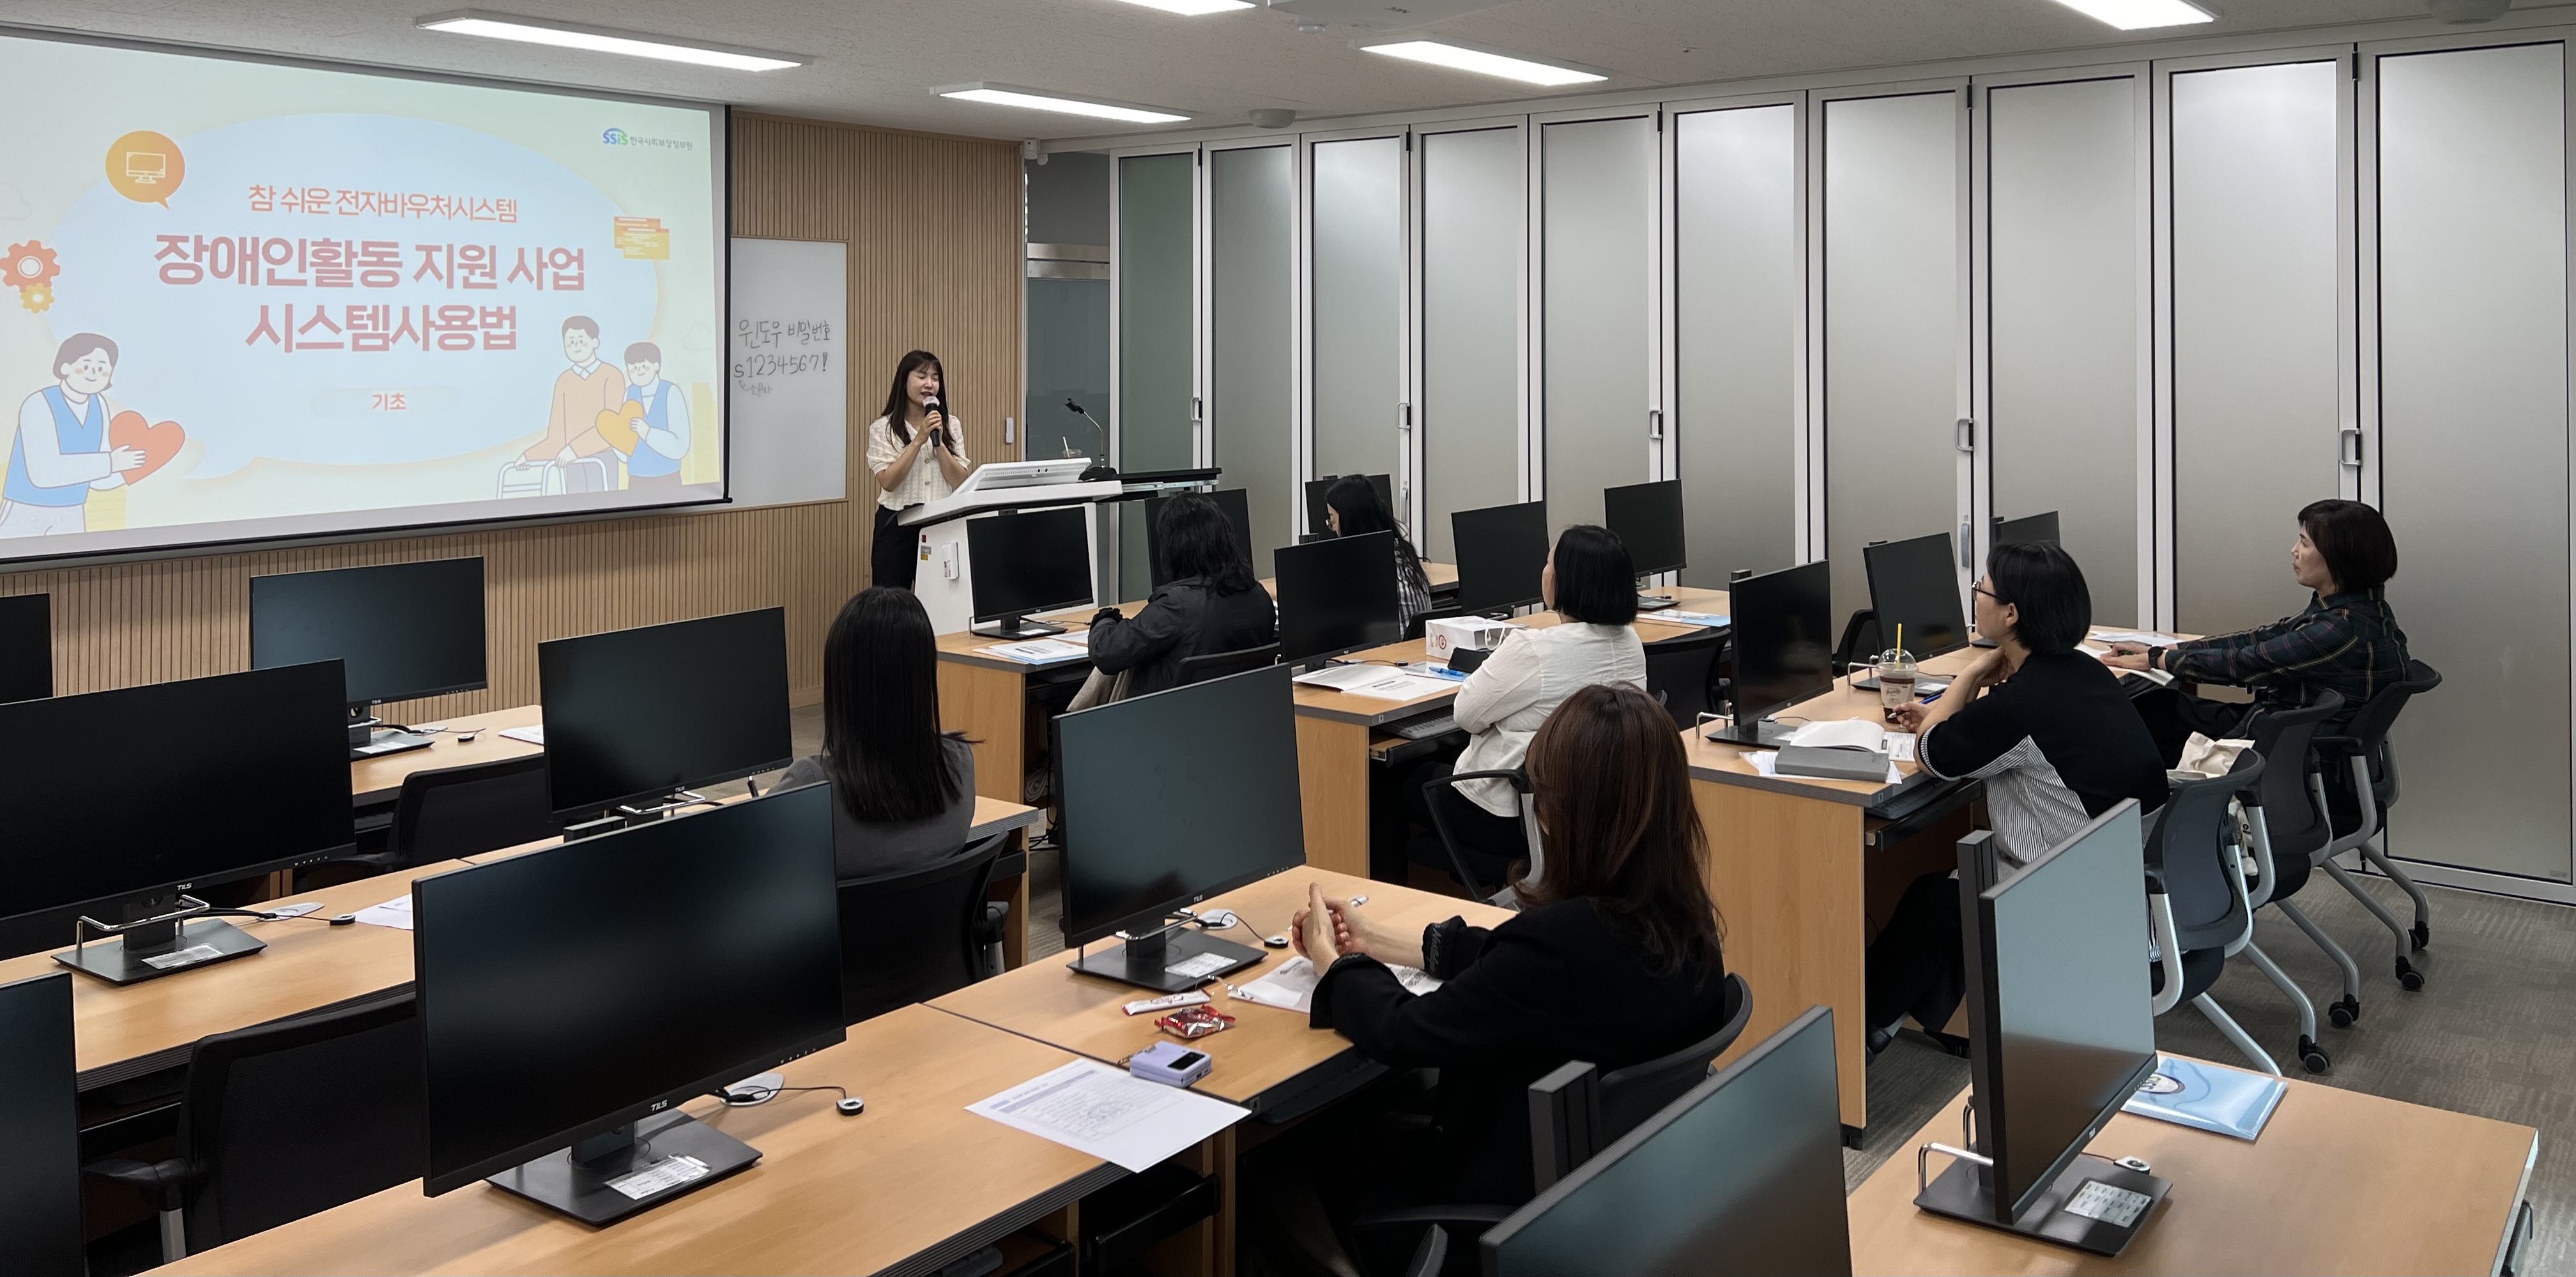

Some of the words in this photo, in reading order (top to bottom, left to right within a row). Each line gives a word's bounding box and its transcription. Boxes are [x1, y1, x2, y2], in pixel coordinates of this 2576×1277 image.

[629, 136, 693, 151] 한국사회보장정보원
[248, 183, 276, 213] 참
[281, 186, 332, 216] 쉬운
[335, 188, 518, 224] 전자바우처시스템
[155, 234, 403, 289] 장애인활동
[413, 243, 498, 290] 지원
[507, 247, 585, 291] 사업
[245, 303, 517, 353] 시스템사용법
[787, 319, 831, 346] 비밀번호
[372, 392, 406, 412] 기초
